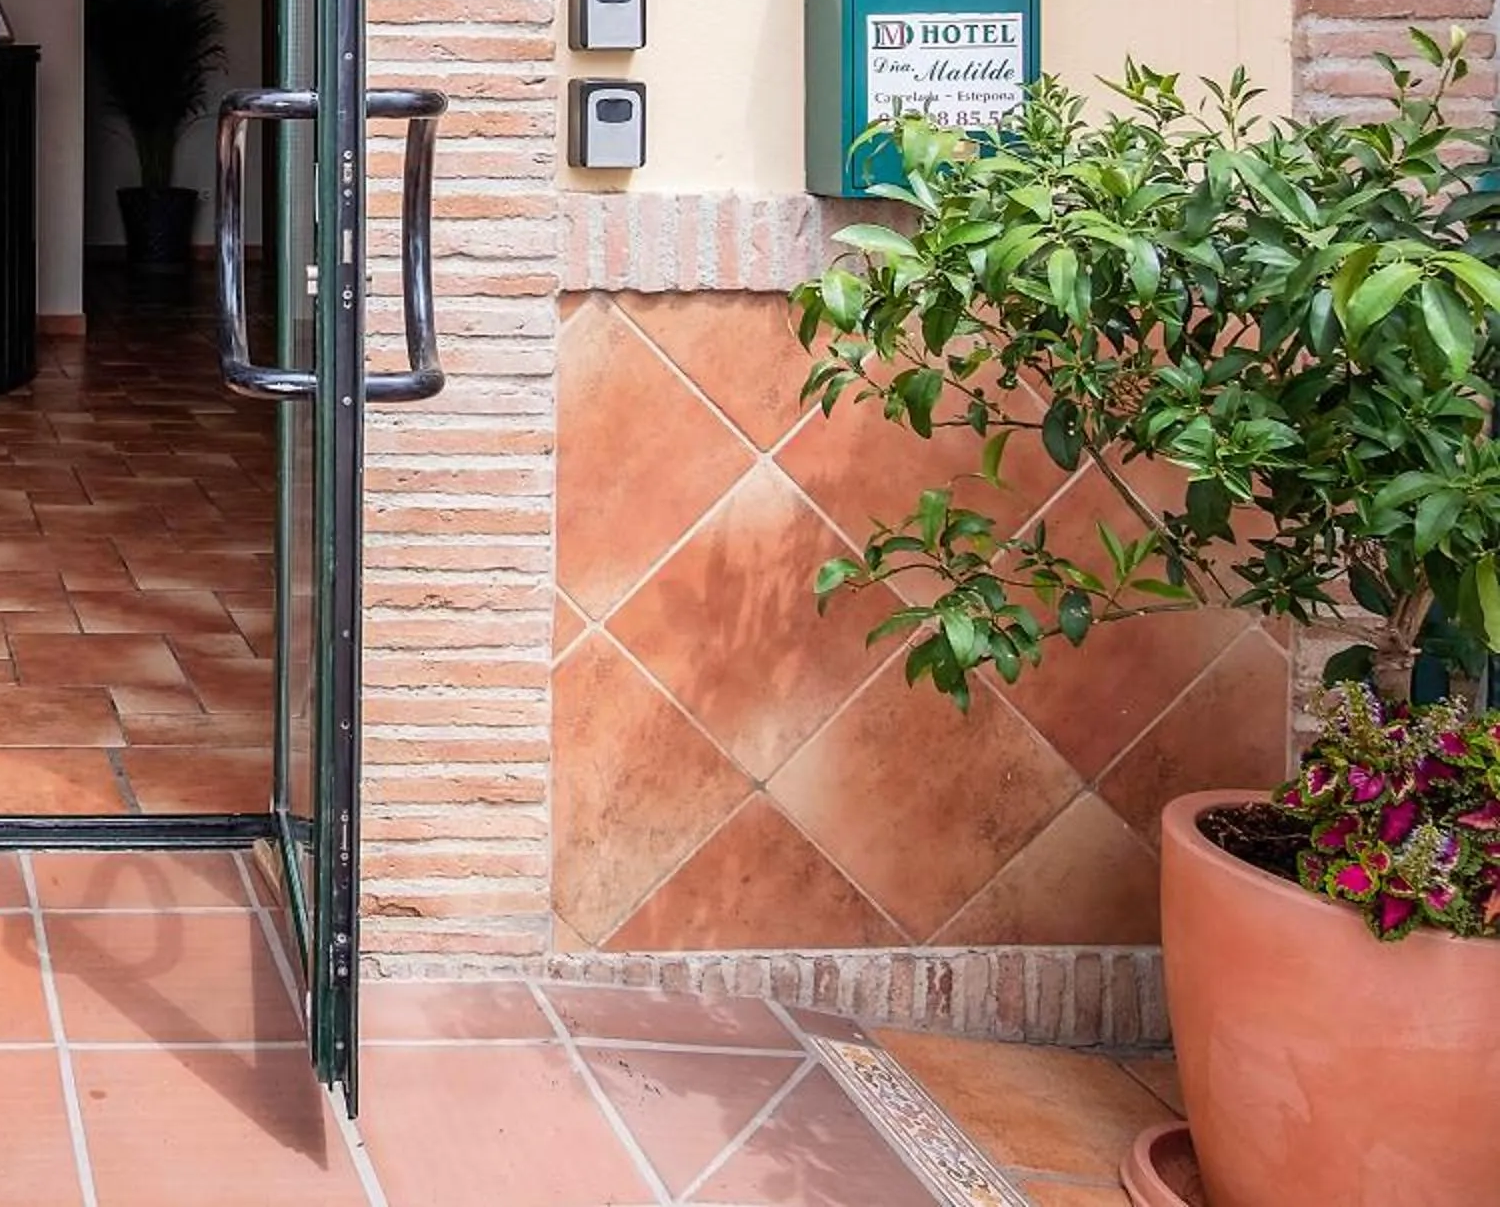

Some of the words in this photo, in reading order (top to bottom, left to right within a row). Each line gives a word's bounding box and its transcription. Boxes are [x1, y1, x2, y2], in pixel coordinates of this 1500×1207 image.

[921, 24, 1015, 45] HOTEL
[913, 58, 1016, 83] Matilde
[957, 91, 1016, 104] Estepona
